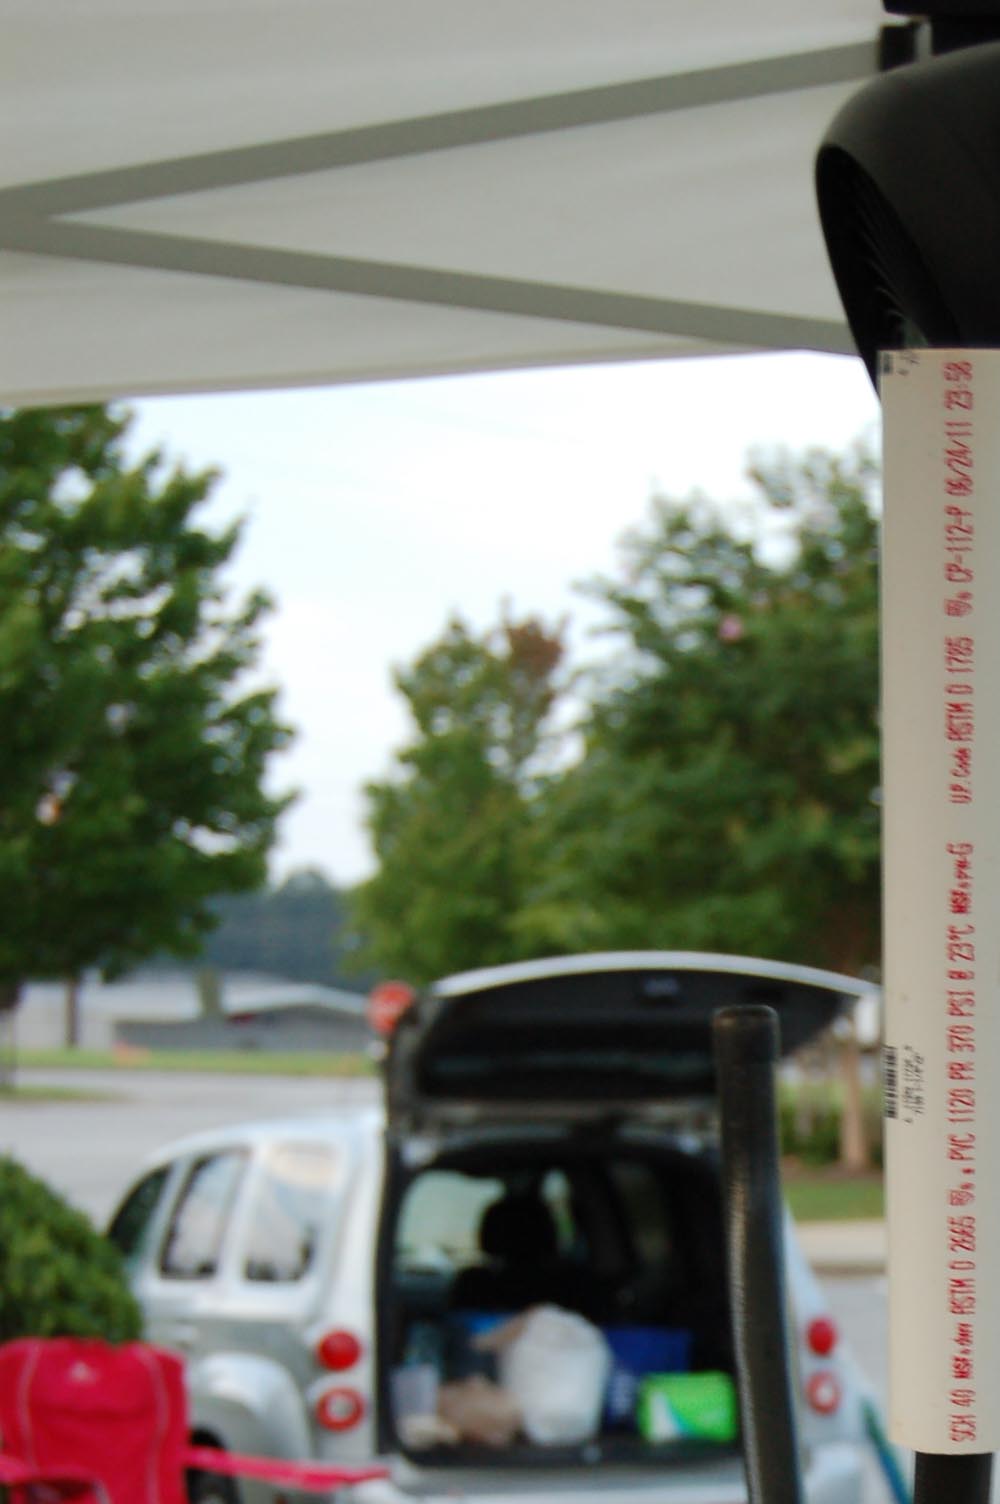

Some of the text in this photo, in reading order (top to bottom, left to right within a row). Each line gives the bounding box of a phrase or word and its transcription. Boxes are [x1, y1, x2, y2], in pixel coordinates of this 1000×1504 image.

[943, 682, 975, 695] D
[943, 701, 975, 742] ASTM
[945, 989, 975, 1018] PSI
[945, 1024, 975, 1051] 370
[945, 1060, 975, 1081] PR
[945, 1087, 975, 1124] 1120
[945, 1134, 975, 1162] PVC
[946, 1215, 976, 1252] 2665
[946, 1260, 975, 1271] D
[946, 1277, 975, 1316] ASTM
[947, 1388, 975, 1408] 40
[947, 1413, 976, 1443] SCH
